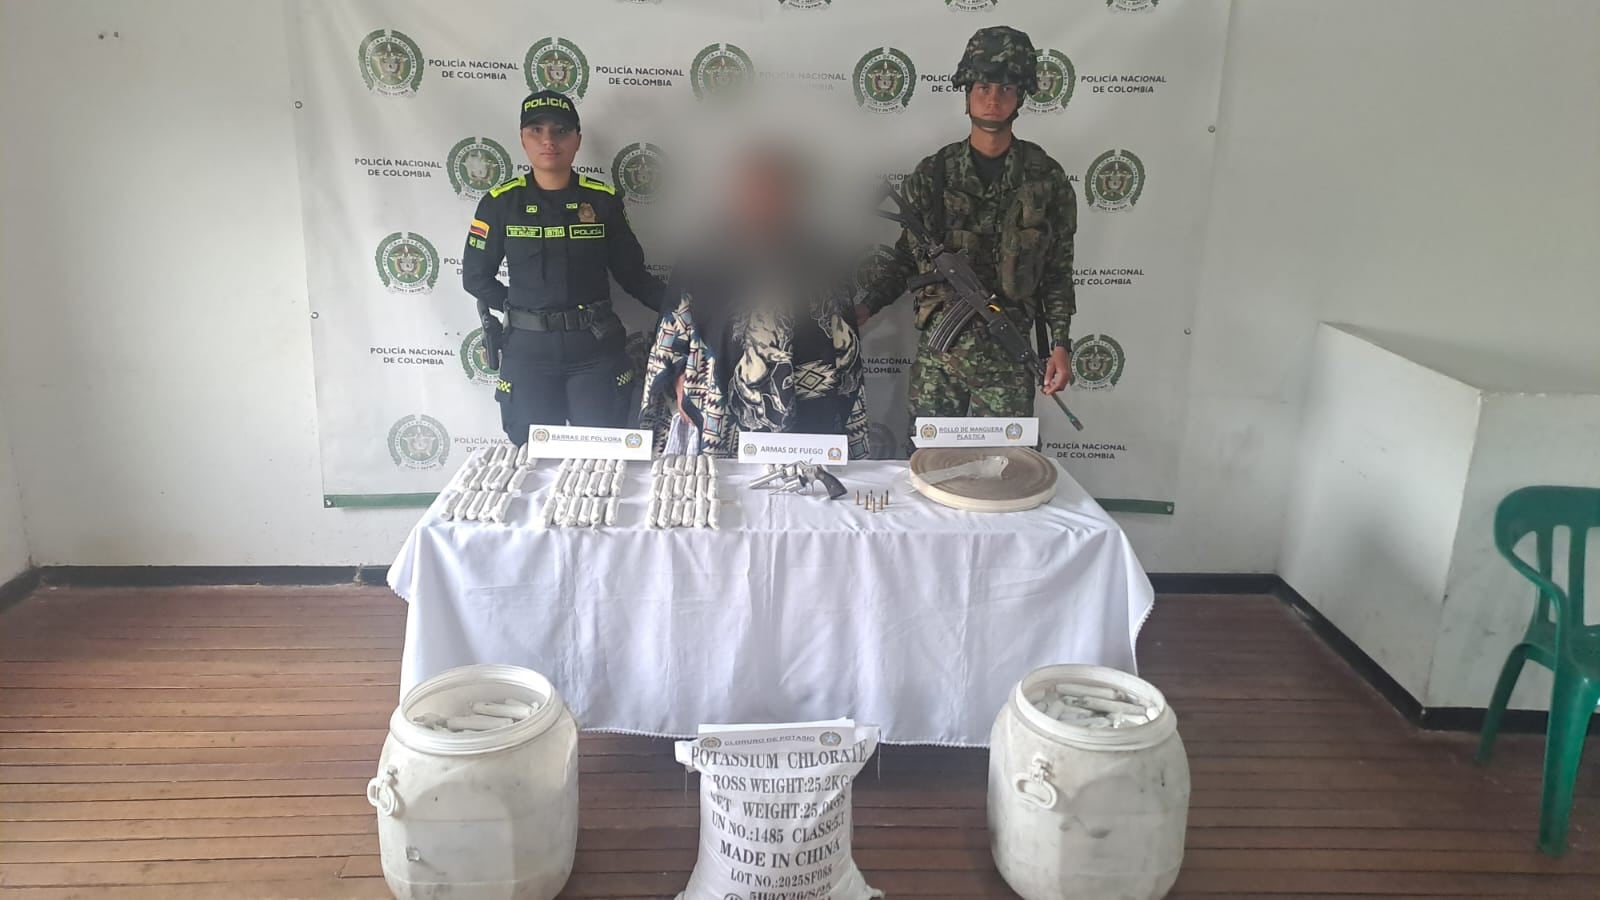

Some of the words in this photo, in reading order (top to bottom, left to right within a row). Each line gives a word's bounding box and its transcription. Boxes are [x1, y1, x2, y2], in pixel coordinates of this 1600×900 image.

[428, 59, 466, 68] POLICÍA
[469, 61, 519, 70] NACIONAL
[457, 71, 507, 80] COLOMBIA
[596, 66, 633, 75] POLICÍA
[635, 68, 684, 77] NACIONAL
[608, 77, 620, 85] DE
[623, 78, 672, 86] COLOMBIA
[921, 74, 954, 82] POLICÍ
[1081, 74, 1118, 83] POLICÍA
[1121, 75, 1167, 83] NACIONAL
[354, 157, 392, 166] POLICÍA
[395, 160, 442, 169] NACIONAL
[382, 169, 431, 178] COLOMBIA
[370, 346, 406, 355] POLICÍA
[408, 348, 456, 357] NACIONAL
[397, 357, 444, 365] COLOMBIA
[760, 446, 787, 454] ARMAS
[799, 447, 824, 455] FUEGO
[1082, 443, 1128, 451] NACIONAL
[779, 735, 815, 743] POTASIO
[691, 746, 779, 768] POTASSIUM
[787, 739, 867, 768] CHLORATE
[711, 774, 746, 791] ROSS
[712, 810, 726, 831] UN
[720, 839, 766, 868] MADE
[772, 852, 791, 868] IN
[795, 838, 841, 867] CHINA
[730, 867, 751, 886] LOT
